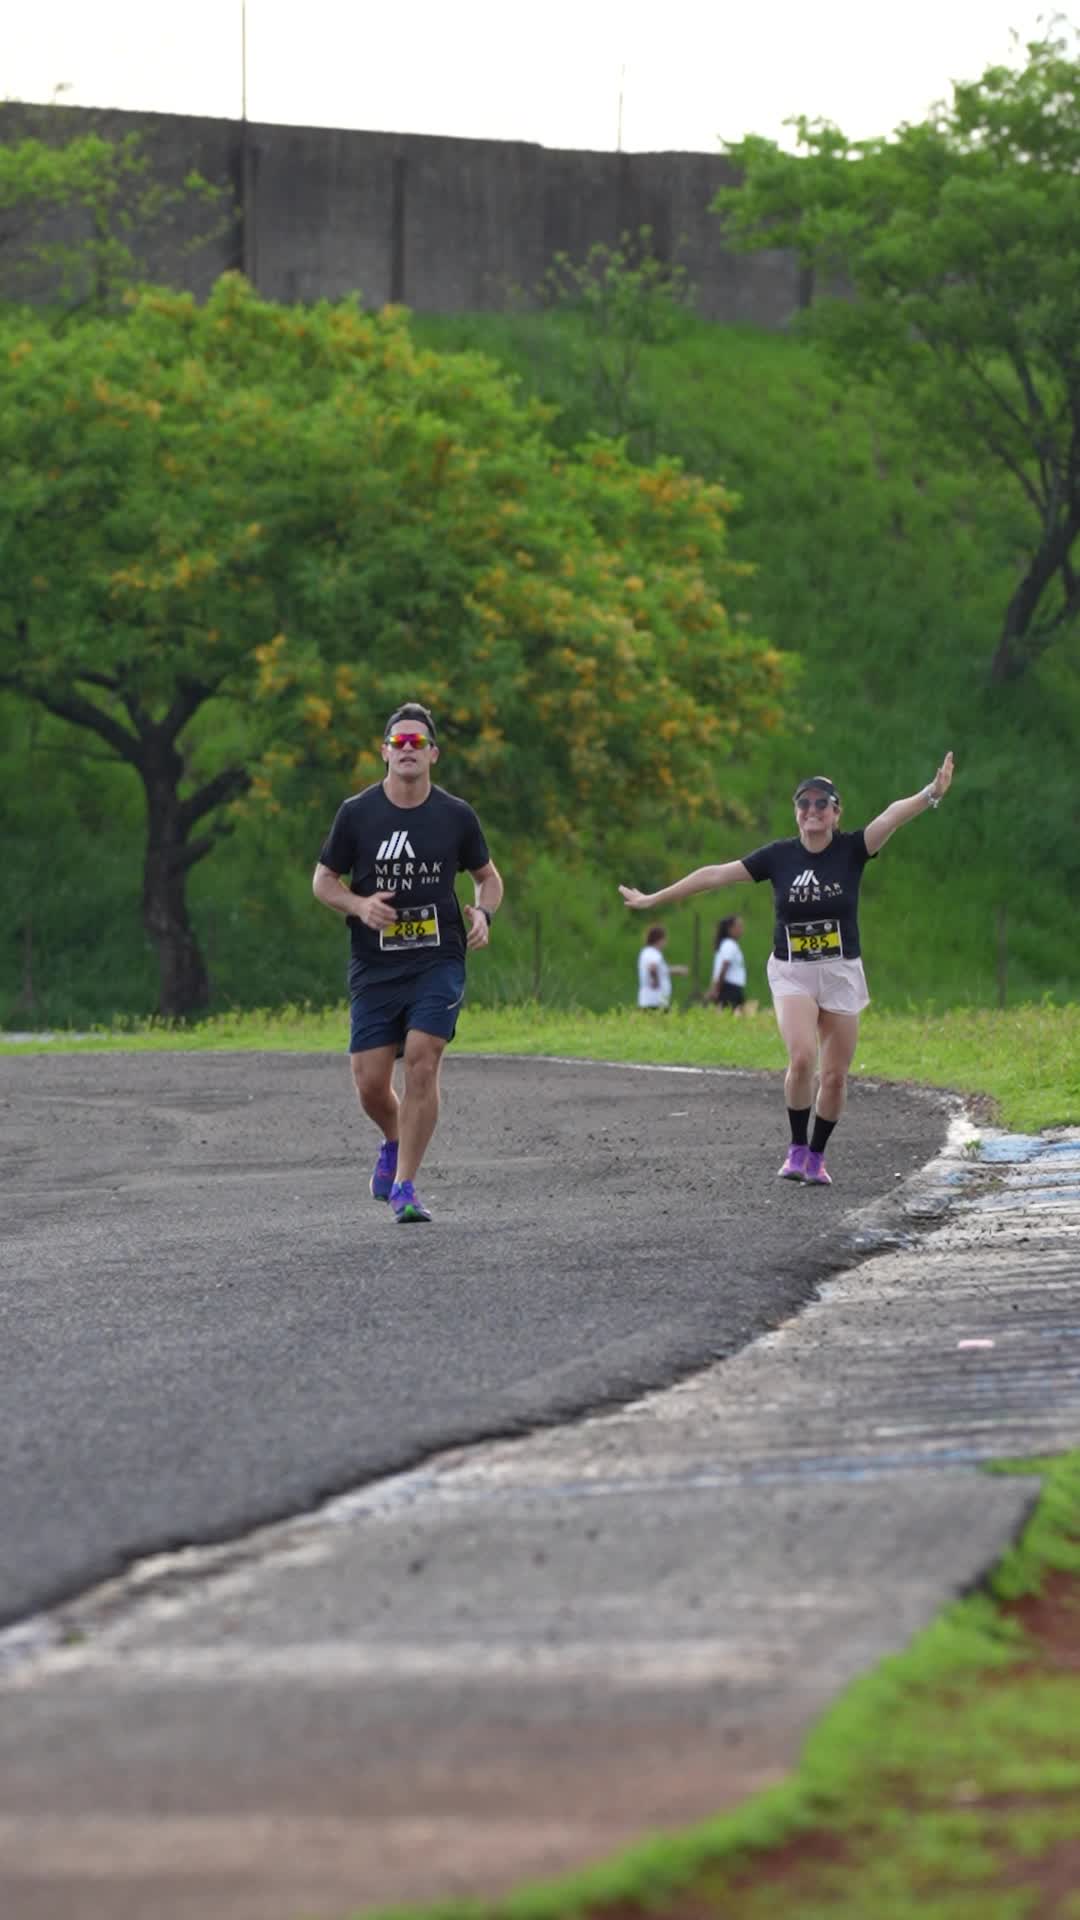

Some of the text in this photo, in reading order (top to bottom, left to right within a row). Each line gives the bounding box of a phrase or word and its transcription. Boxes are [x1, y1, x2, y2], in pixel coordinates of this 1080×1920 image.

[375, 862, 442, 876] MERAK
[376, 877, 413, 890] RUN
[790, 883, 840, 895] MERAK
[789, 894, 820, 903] RUN
[395, 922, 425, 936] 286
[800, 935, 829, 951] 285
